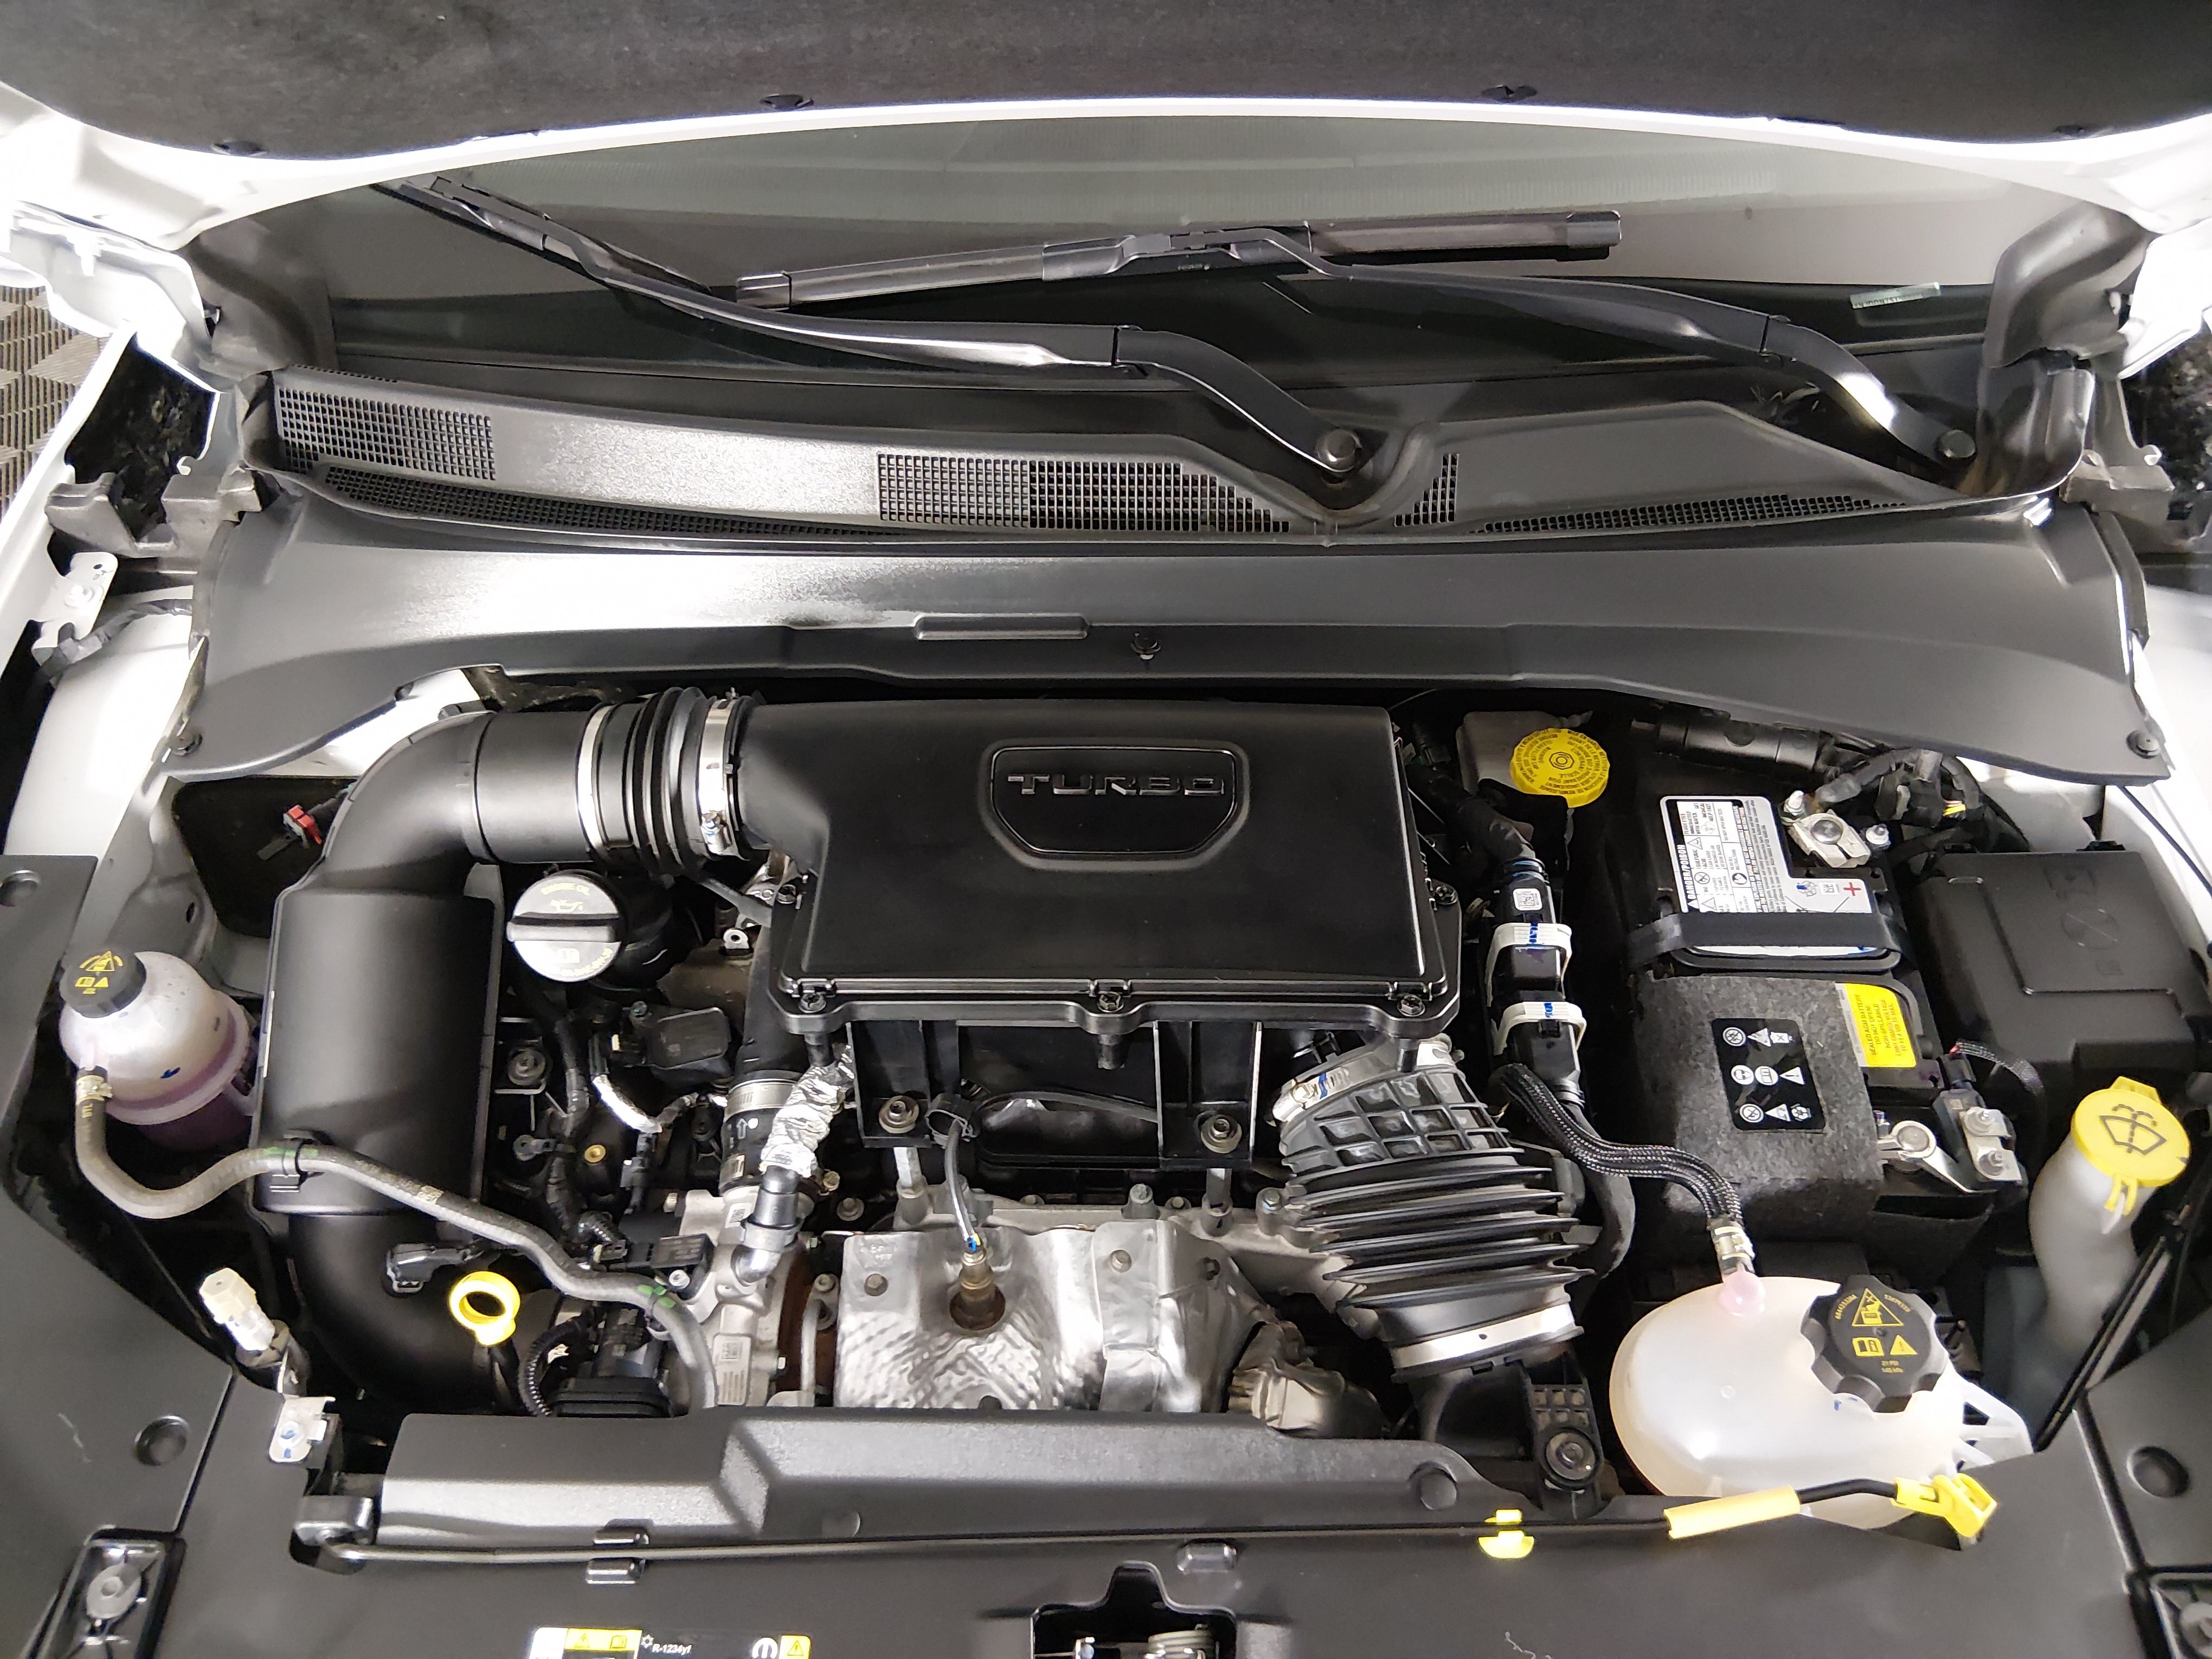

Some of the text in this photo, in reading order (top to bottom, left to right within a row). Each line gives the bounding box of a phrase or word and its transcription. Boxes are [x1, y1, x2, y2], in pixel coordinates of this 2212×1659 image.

[1007, 773, 1225, 795] TURBO
[1677, 845, 1696, 899] DANGER/POISON
[541, 883, 590, 896] ENGINE OIL
[1855, 994, 1866, 1018] BATTERY
[1874, 1004, 1891, 1047] NON-SPILLABLE
[1867, 1034, 1876, 1055] SEALED
